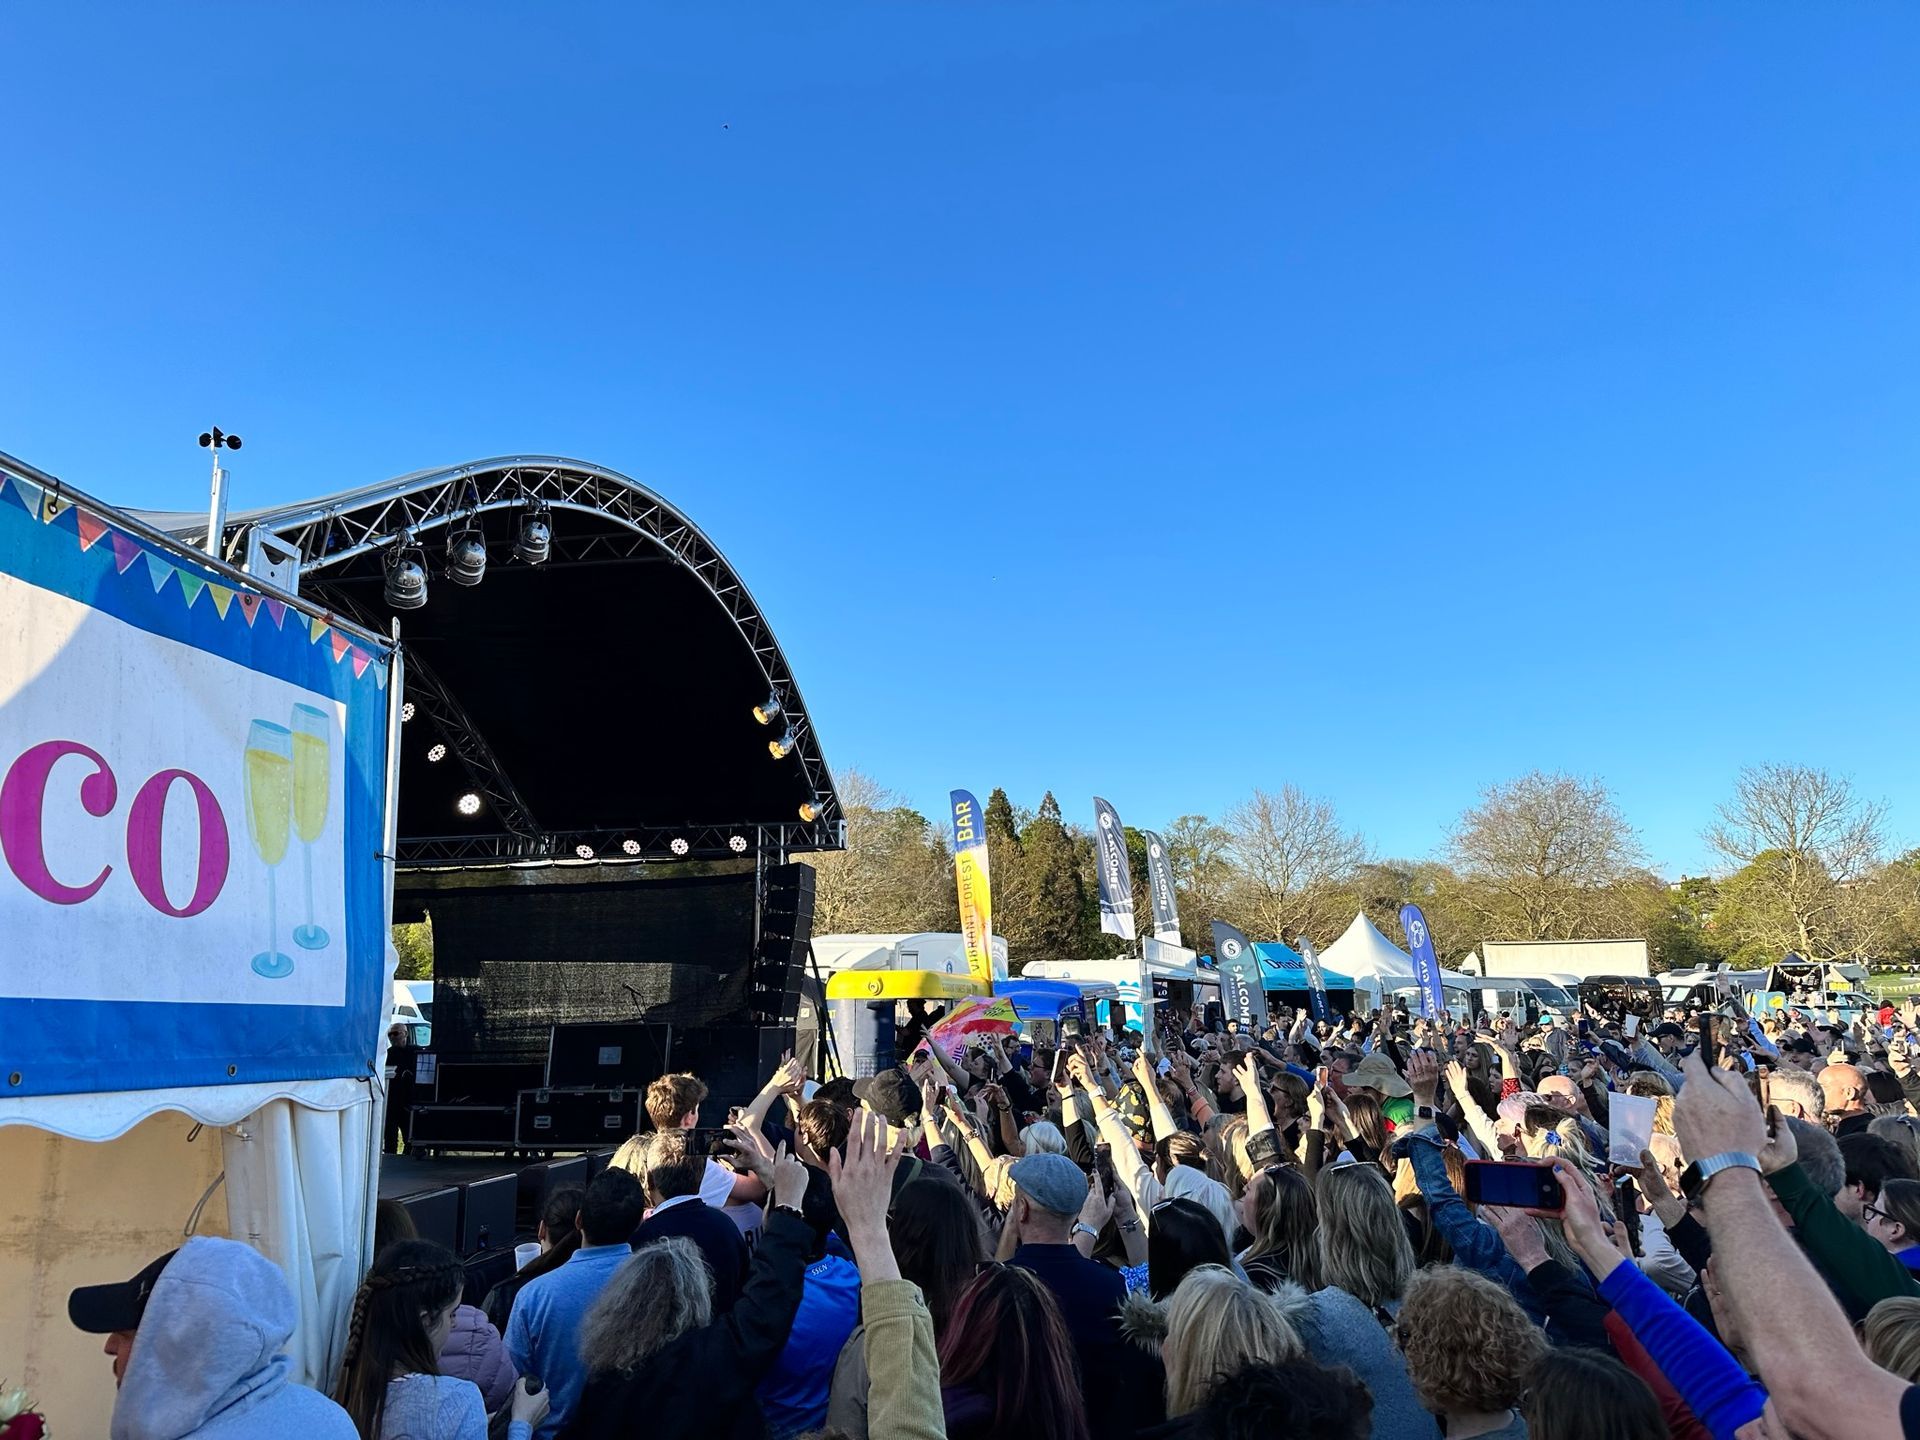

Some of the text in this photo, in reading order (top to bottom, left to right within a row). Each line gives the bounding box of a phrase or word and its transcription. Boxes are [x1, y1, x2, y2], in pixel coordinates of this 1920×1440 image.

[955, 799, 974, 842] BAR
[1107, 833, 1119, 890] SALCOMBE
[1157, 862, 1168, 911] SALCOMBE
[962, 859, 980, 972] VIBRANT FOREST
[1230, 977, 1238, 1007] BREWERY
[1232, 965, 1250, 1032] SALCOMBE
